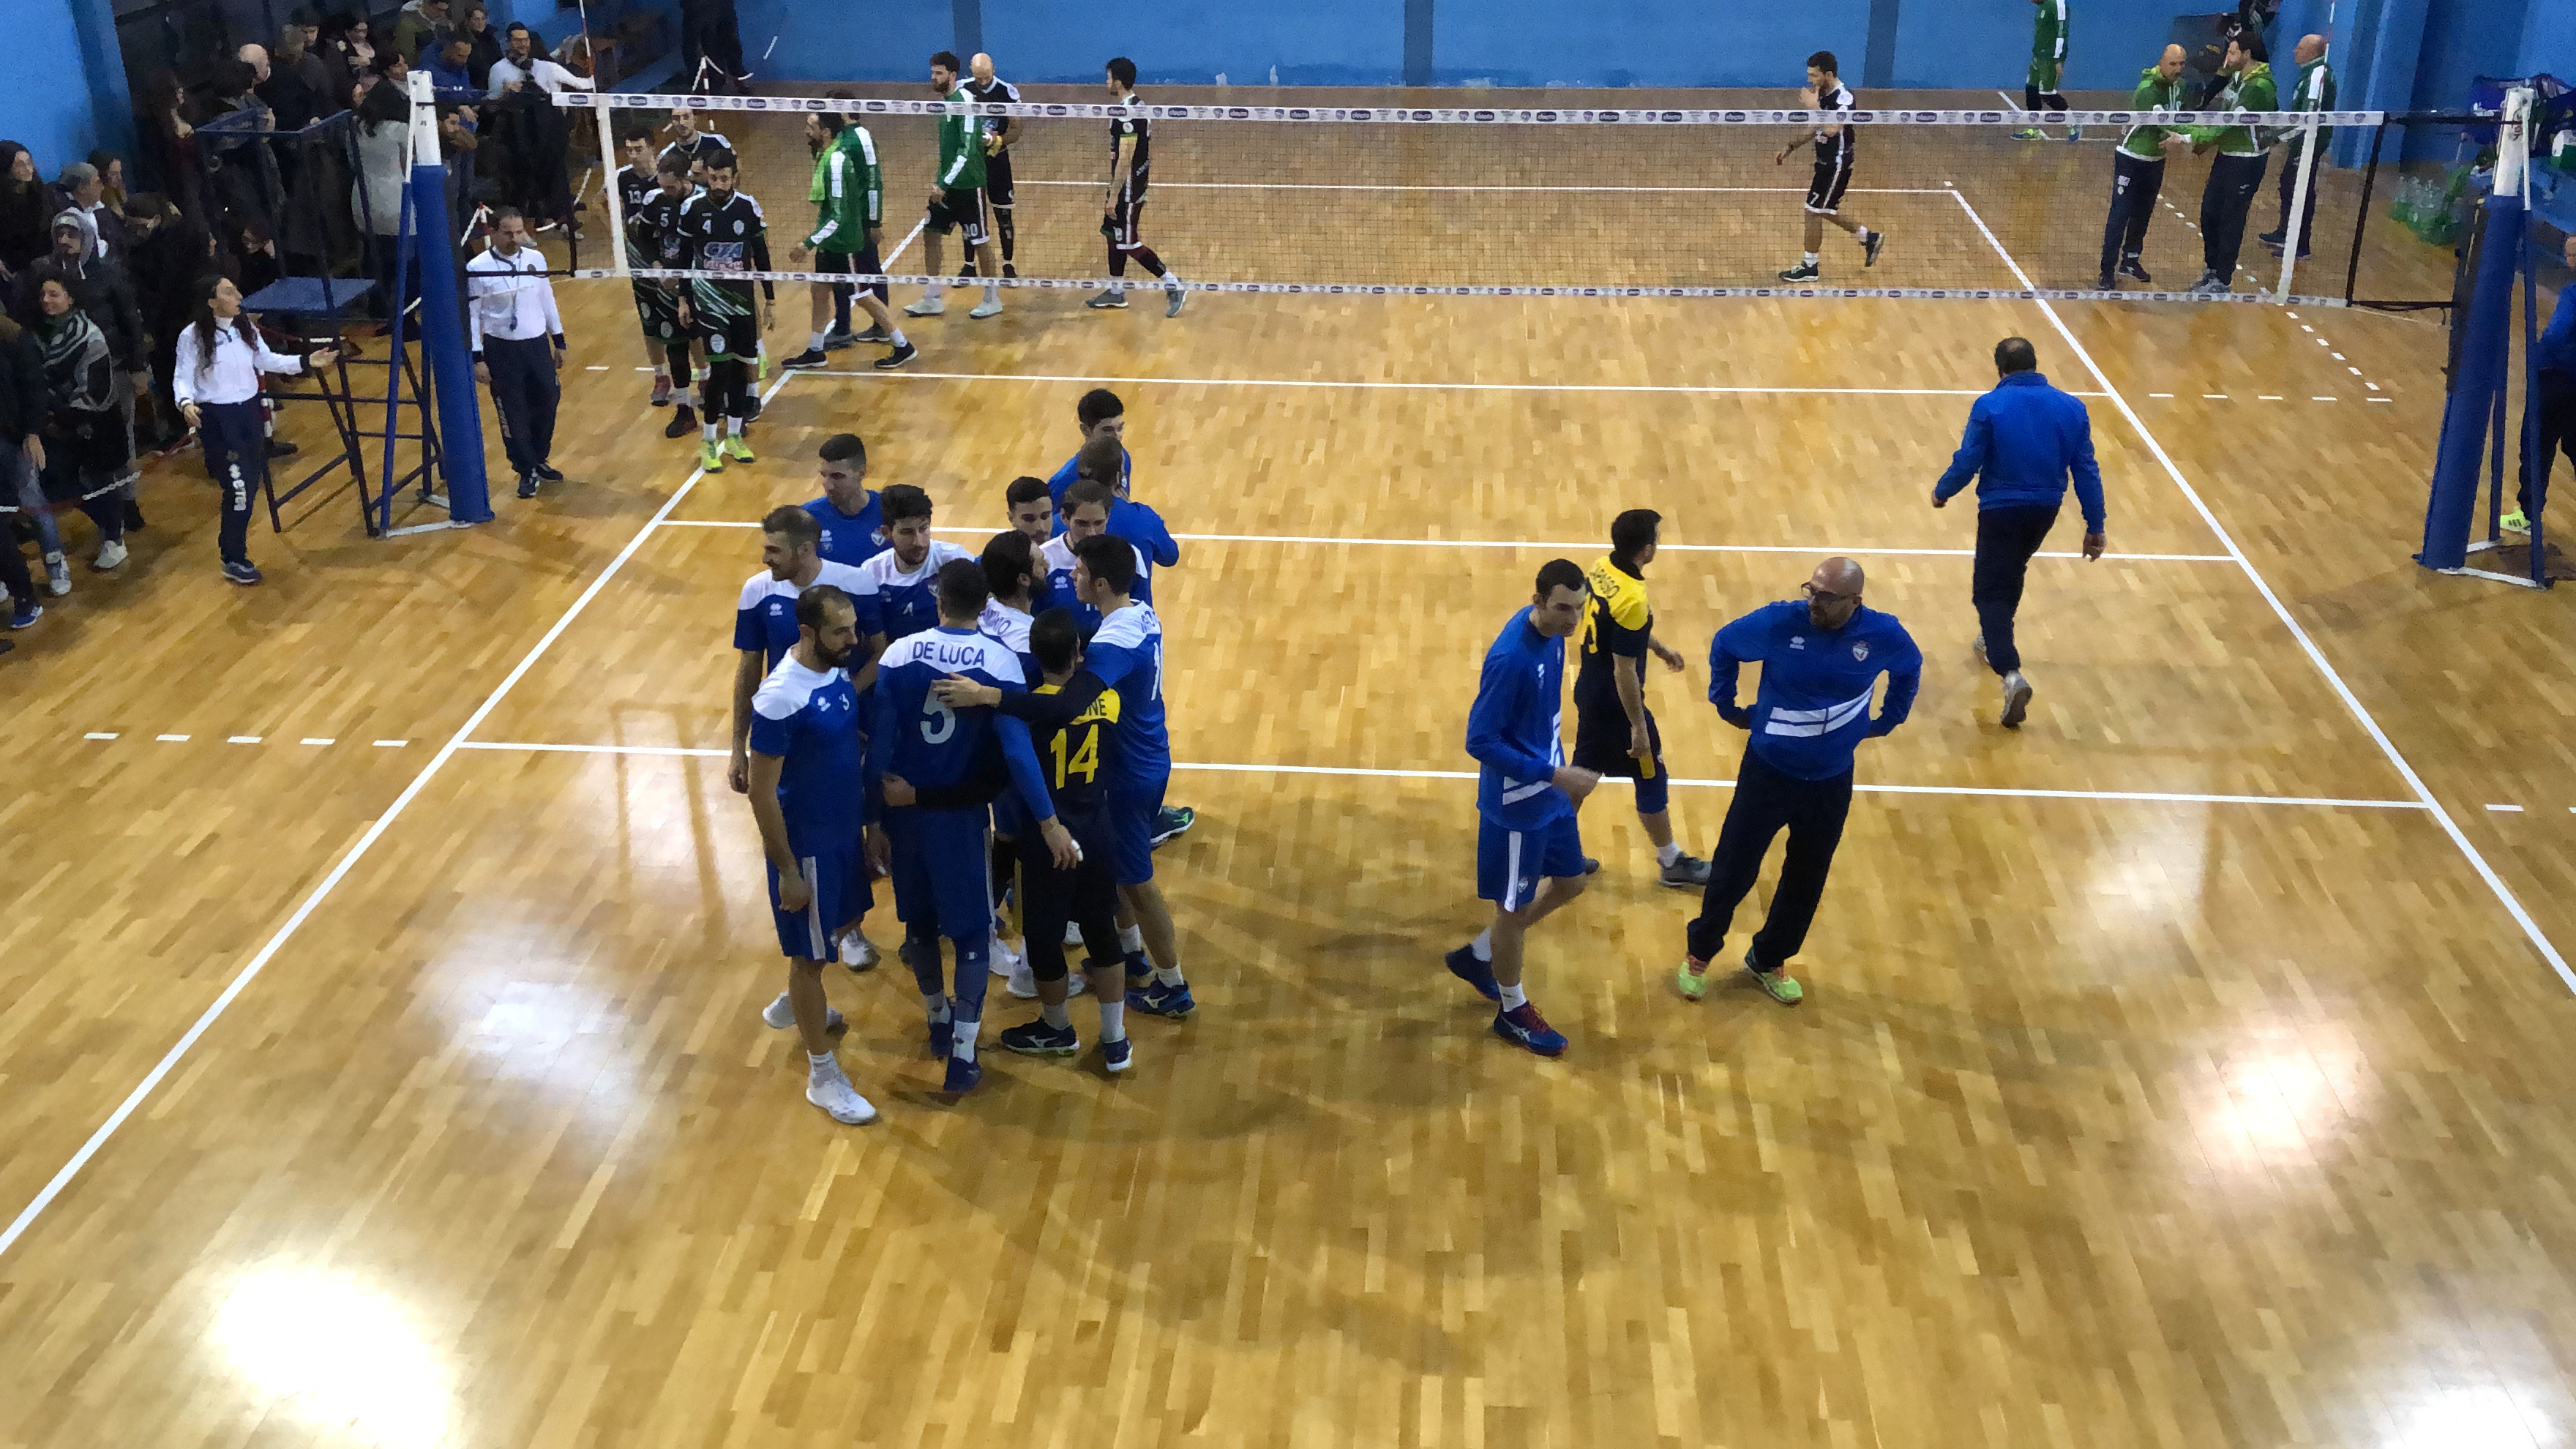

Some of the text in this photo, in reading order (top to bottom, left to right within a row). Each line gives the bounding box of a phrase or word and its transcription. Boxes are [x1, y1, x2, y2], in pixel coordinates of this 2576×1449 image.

[628, 190, 642, 204] 13
[1810, 192, 1819, 205] 7
[660, 213, 669, 228] 5
[702, 220, 711, 235] 4
[913, 641, 985, 667] DE LUCA
[920, 679, 956, 744] 5
[1050, 724, 1098, 790] 14
